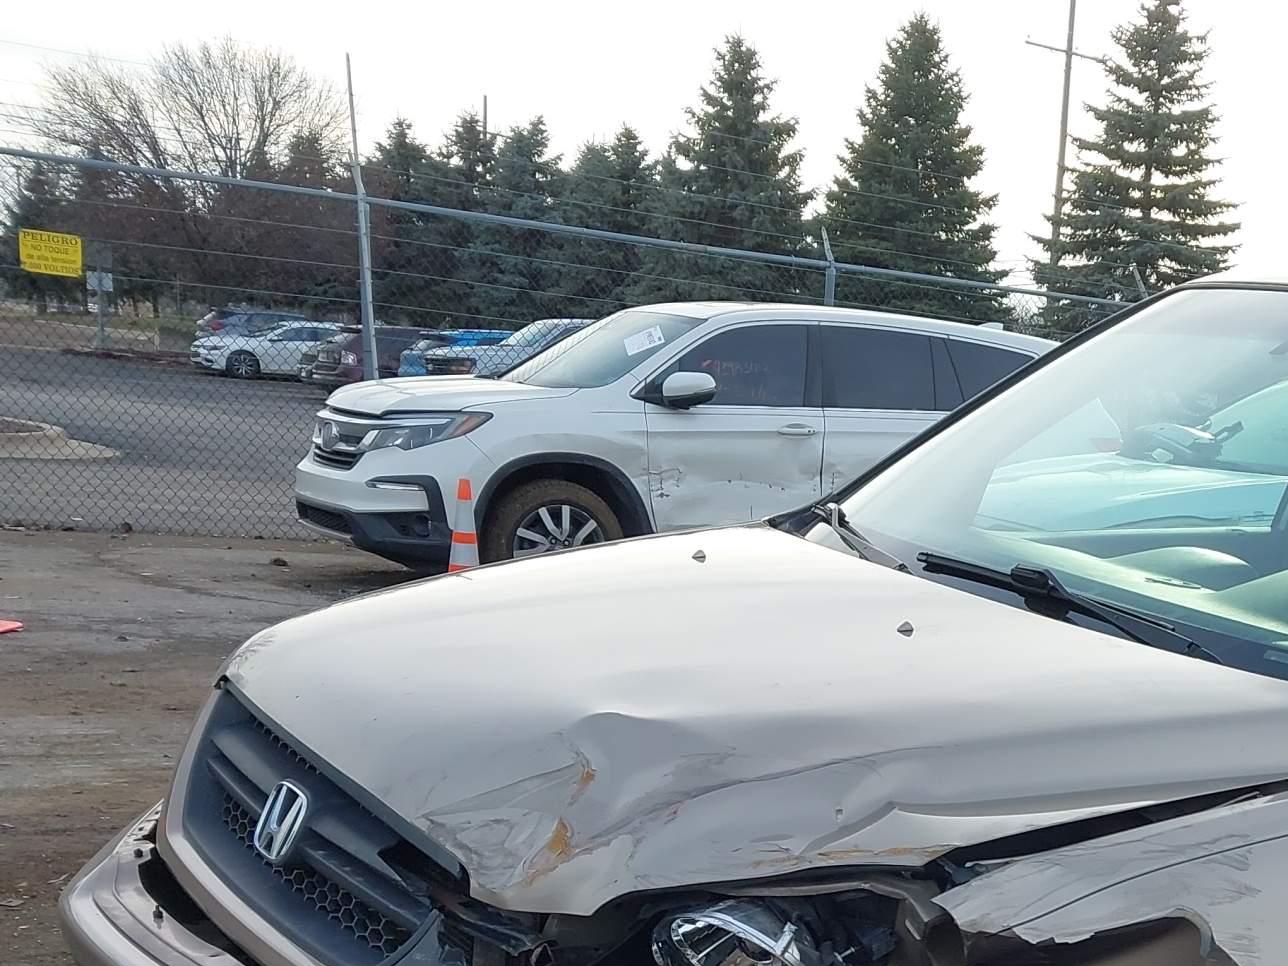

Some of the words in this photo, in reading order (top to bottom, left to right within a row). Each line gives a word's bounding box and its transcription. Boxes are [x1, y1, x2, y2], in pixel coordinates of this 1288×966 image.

[22, 231, 78, 246] PELIGRO
[30, 243, 42, 252] NO
[43, 244, 71, 255] TOQUE
[43, 262, 79, 274] VOLTIOS
